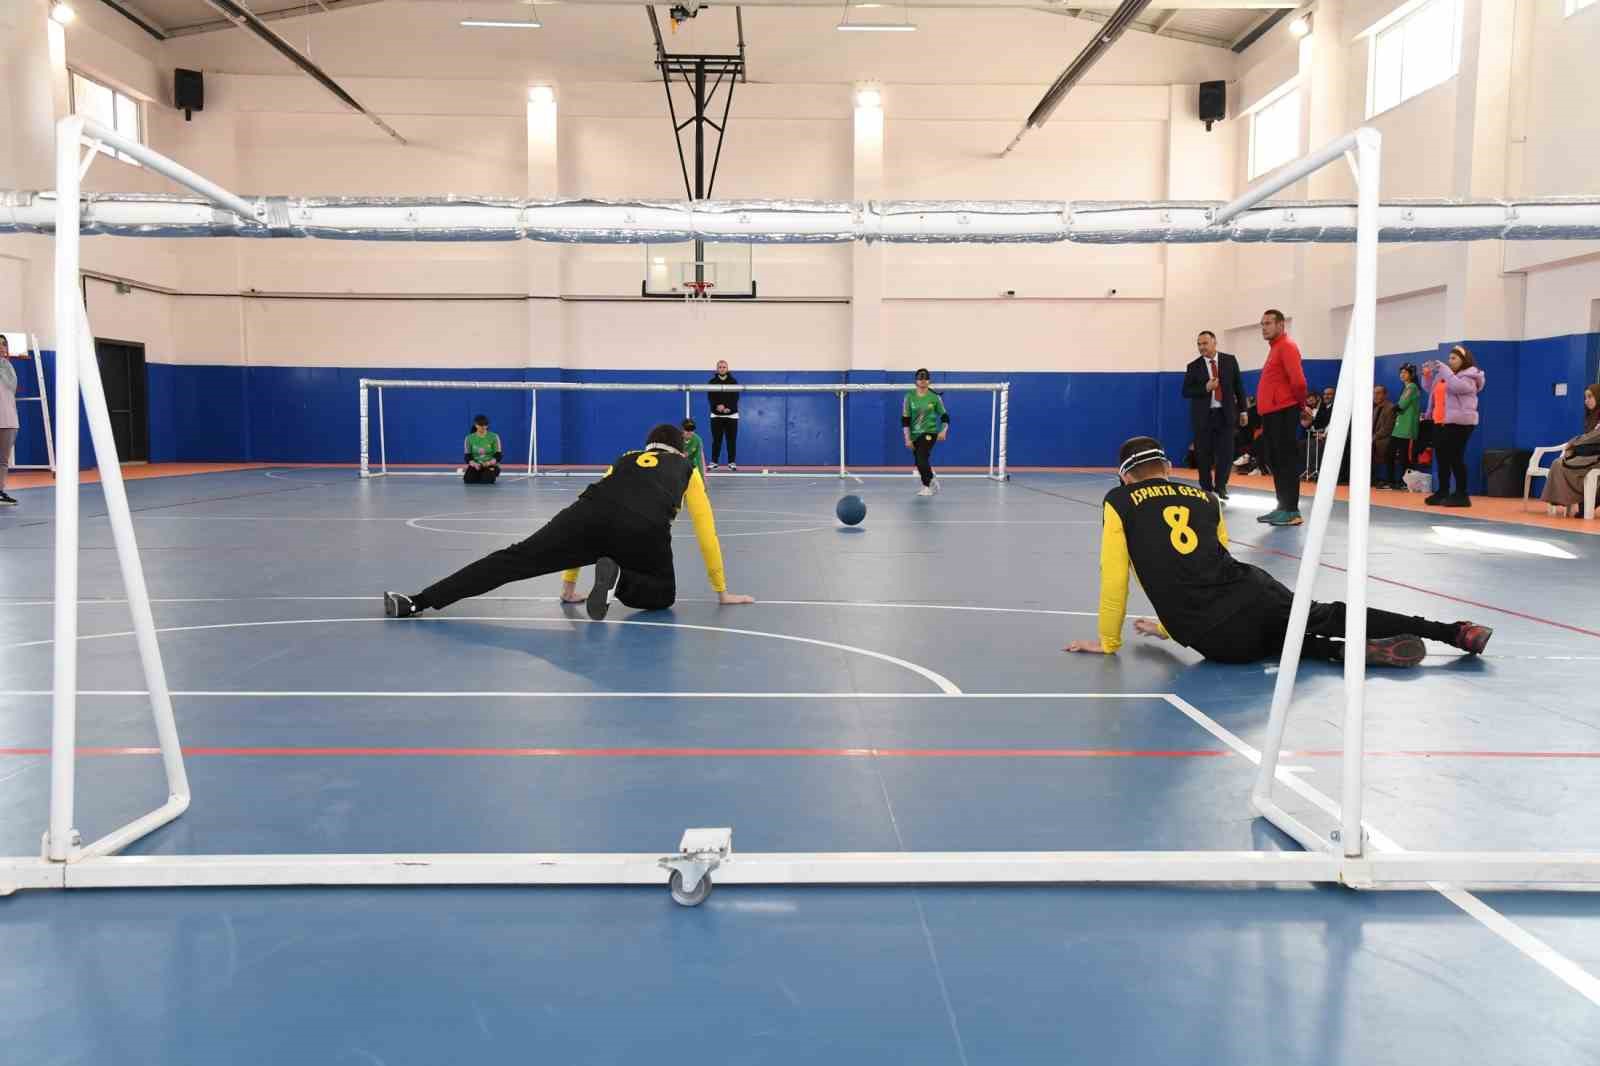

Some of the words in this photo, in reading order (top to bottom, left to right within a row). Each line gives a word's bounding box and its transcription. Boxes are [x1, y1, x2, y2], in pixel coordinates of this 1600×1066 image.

[635, 451, 659, 468] 6
[1130, 485, 1177, 506] ISPARTA
[1163, 505, 1198, 555] 8
